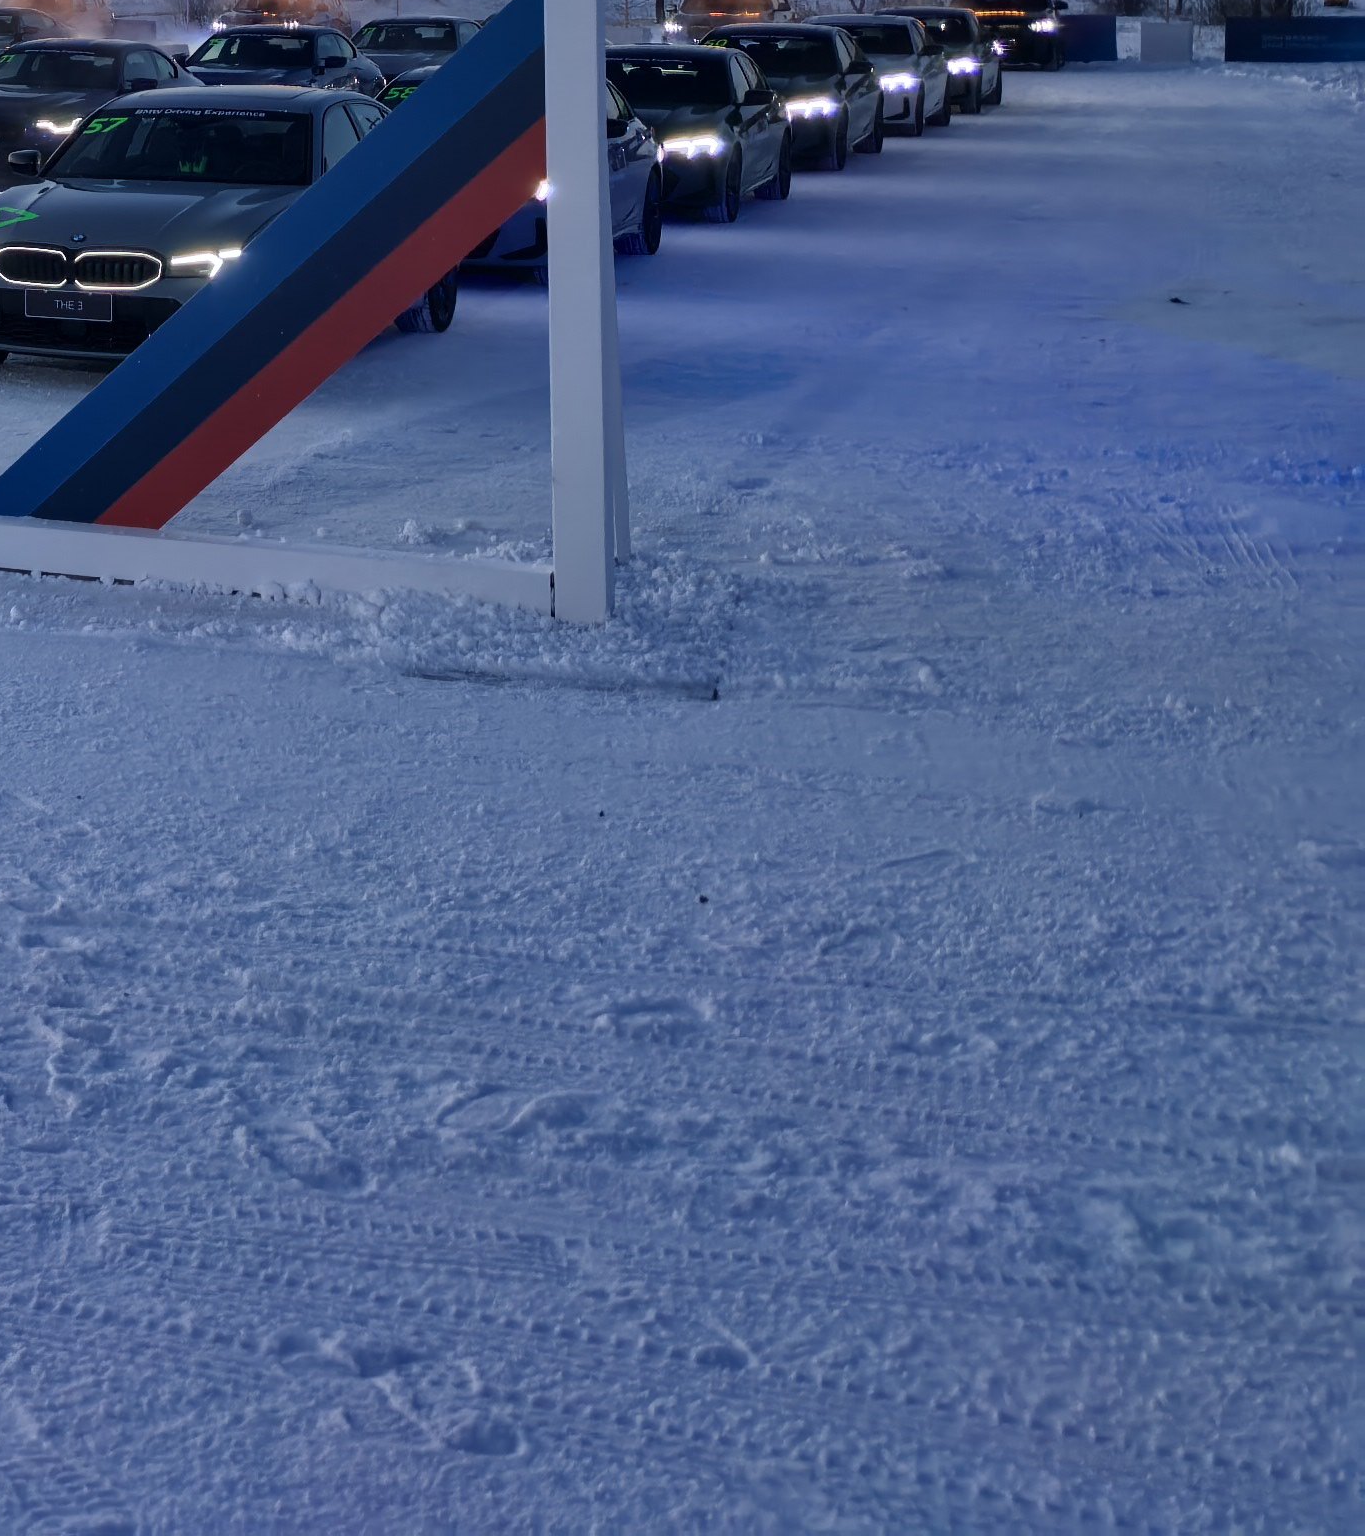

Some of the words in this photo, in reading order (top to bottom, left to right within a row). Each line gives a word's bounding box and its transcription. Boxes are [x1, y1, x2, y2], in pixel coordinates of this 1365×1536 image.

[135, 107, 165, 115] BMW
[165, 107, 202, 117] Driving
[204, 109, 266, 118] Experience
[83, 117, 129, 134] 57
[54, 299, 75, 310] THE
[77, 300, 84, 311] 3
